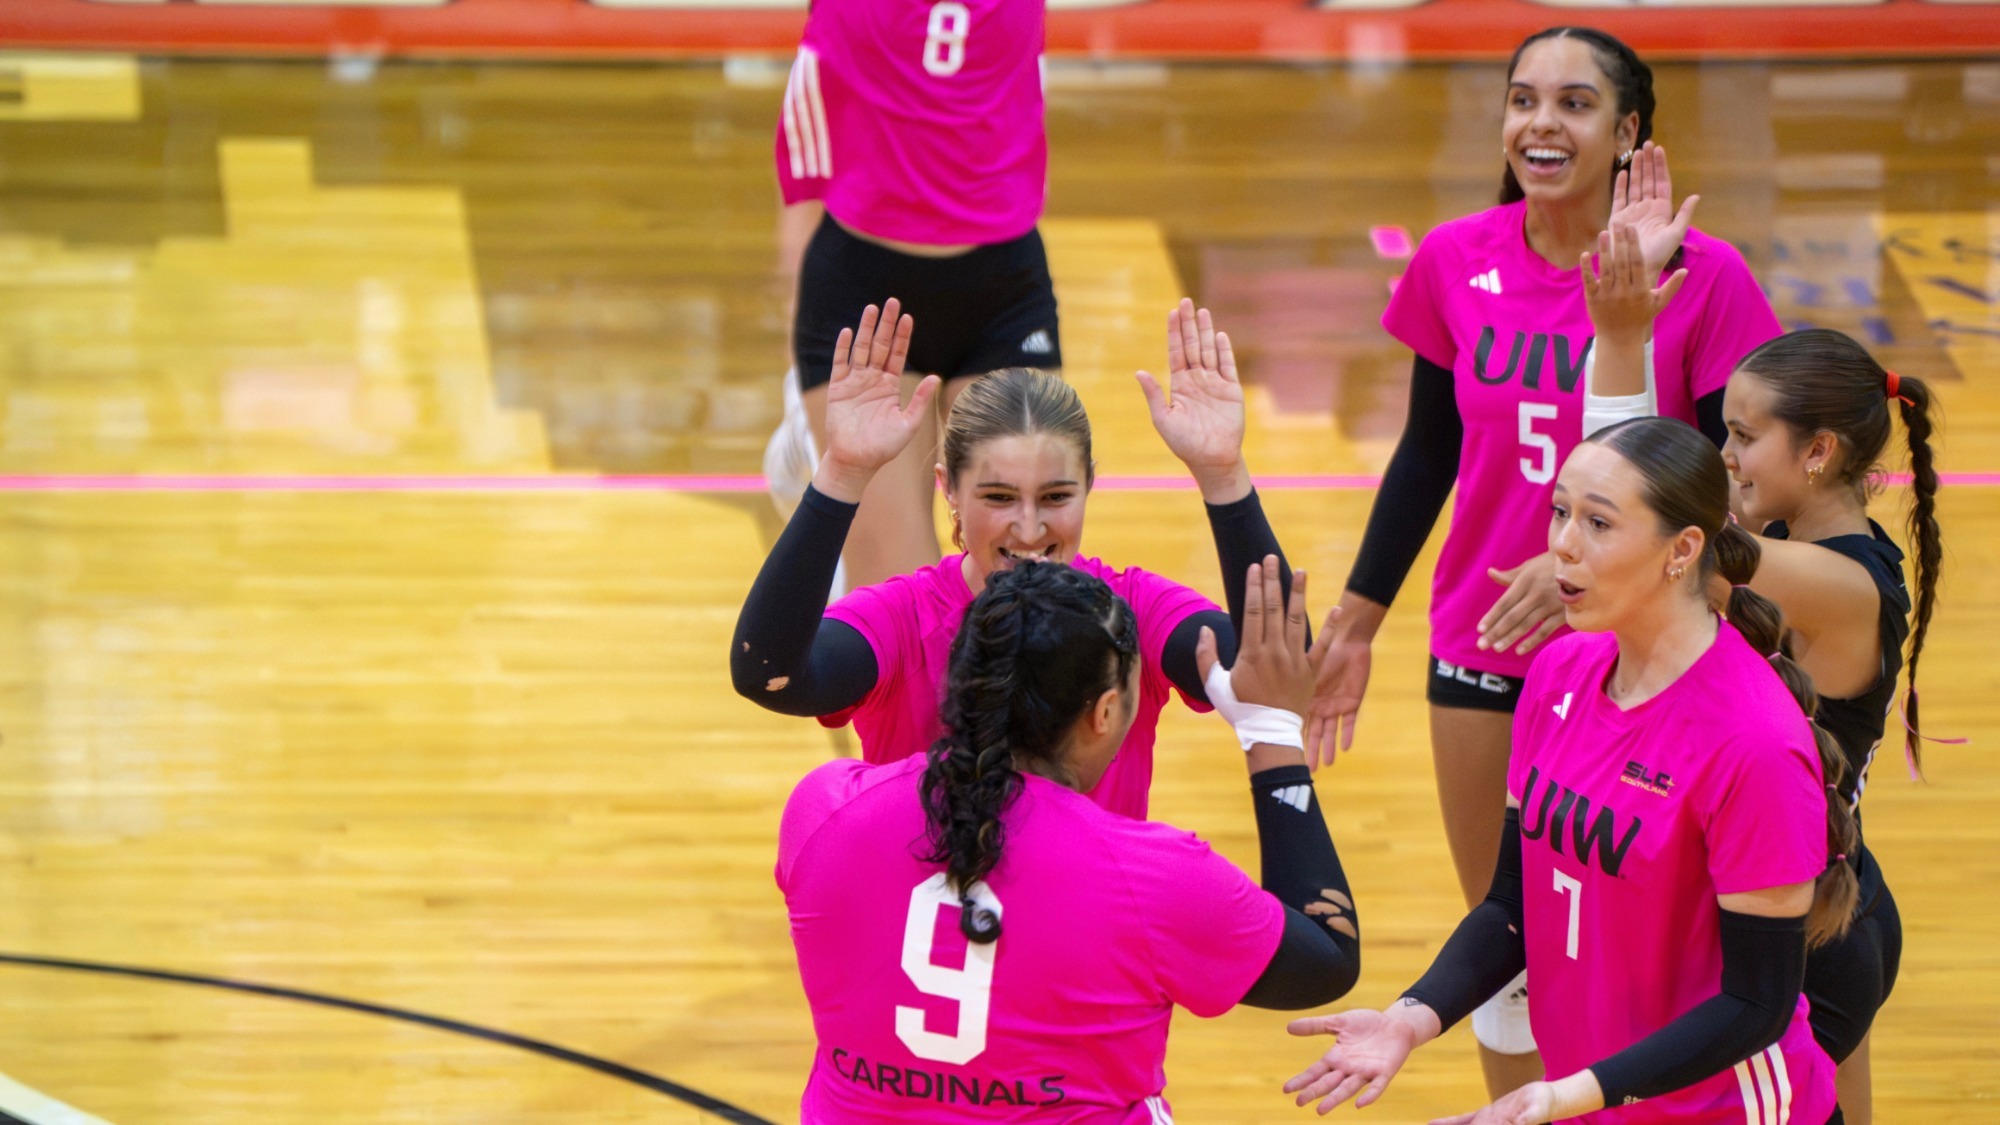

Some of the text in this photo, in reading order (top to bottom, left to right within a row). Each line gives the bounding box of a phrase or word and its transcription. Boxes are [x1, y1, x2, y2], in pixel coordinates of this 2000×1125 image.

[922, 1, 970, 77] 8
[1518, 400, 1559, 485] 5
[1521, 765, 1642, 878] UIW
[1553, 867, 1582, 960] 7
[895, 872, 1003, 1065] 9
[832, 1047, 1066, 1107] CARDINALS
